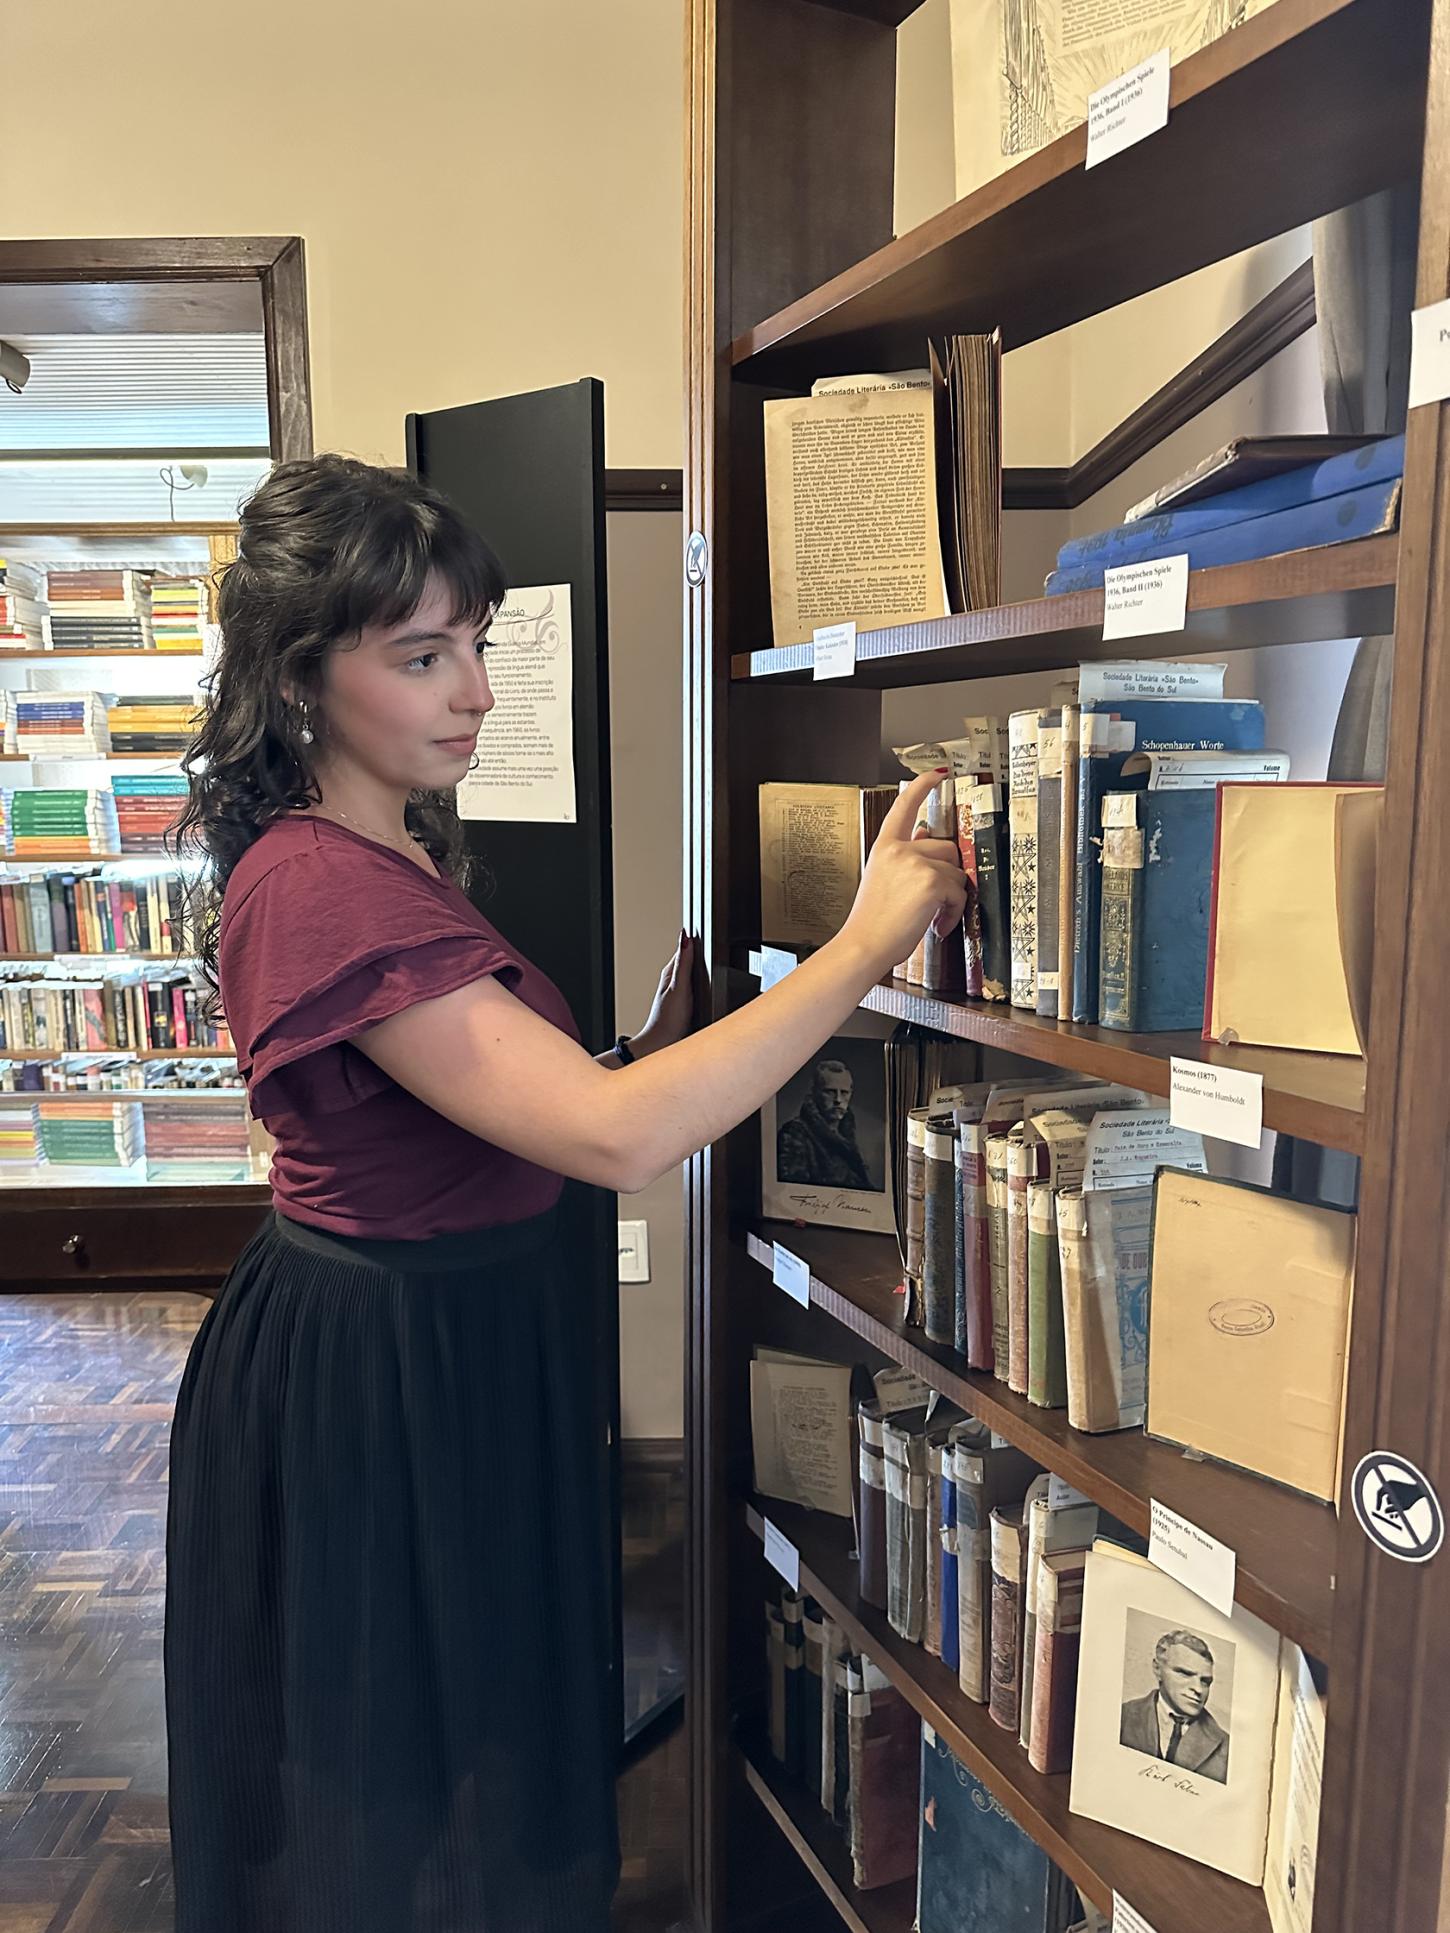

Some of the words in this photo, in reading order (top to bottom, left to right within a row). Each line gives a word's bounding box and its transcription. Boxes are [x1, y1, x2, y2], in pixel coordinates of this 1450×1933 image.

[1090, 102, 1099, 112] Die
[1100, 79, 1136, 104] Olympischen
[1137, 67, 1154, 82] Spiele
[1106, 102, 1120, 116] Band
[1125, 87, 1143, 105] (1936)
[1090, 128, 1106, 142] Walter
[1107, 117, 1126, 132] Richter
[856, 385, 886, 394] Literária
[1117, 570, 1153, 583] Olympischen
[1154, 565, 1172, 576] Spiele
[1122, 585, 1137, 594] Band
[1144, 580, 1163, 592] (1936)
[1107, 602, 1122, 610] Walter
[1124, 600, 1143, 609] Richter
[1103, 672, 1133, 681] Sociedade
[1135, 673, 1158, 683] Literária
[1123, 682, 1135, 692] São
[1138, 685, 1155, 693] Bento
[1167, 685, 1177, 694] Sul
[1142, 740, 1195, 752] Schopenhauer
[1200, 740, 1224, 750] Worte
[1172, 1066, 1196, 1078] Kosmos
[1197, 1071, 1217, 1082] (1877)
[1172, 1082, 1202, 1096] Alexander
[1215, 1091, 1245, 1105] Humboldt
[1100, 1119, 1135, 1129] Sociedade
[1122, 1130, 1134, 1138] São
[1136, 1129, 1152, 1137] Bento
[1165, 1127, 1175, 1135] Sul
[1152, 1517, 1170, 1534] (1925)
[1152, 1505, 1158, 1514] O
[1183, 1527, 1191, 1536] de
[1192, 1531, 1214, 1551] Nassau
[1151, 1530, 1167, 1546] Paulo
